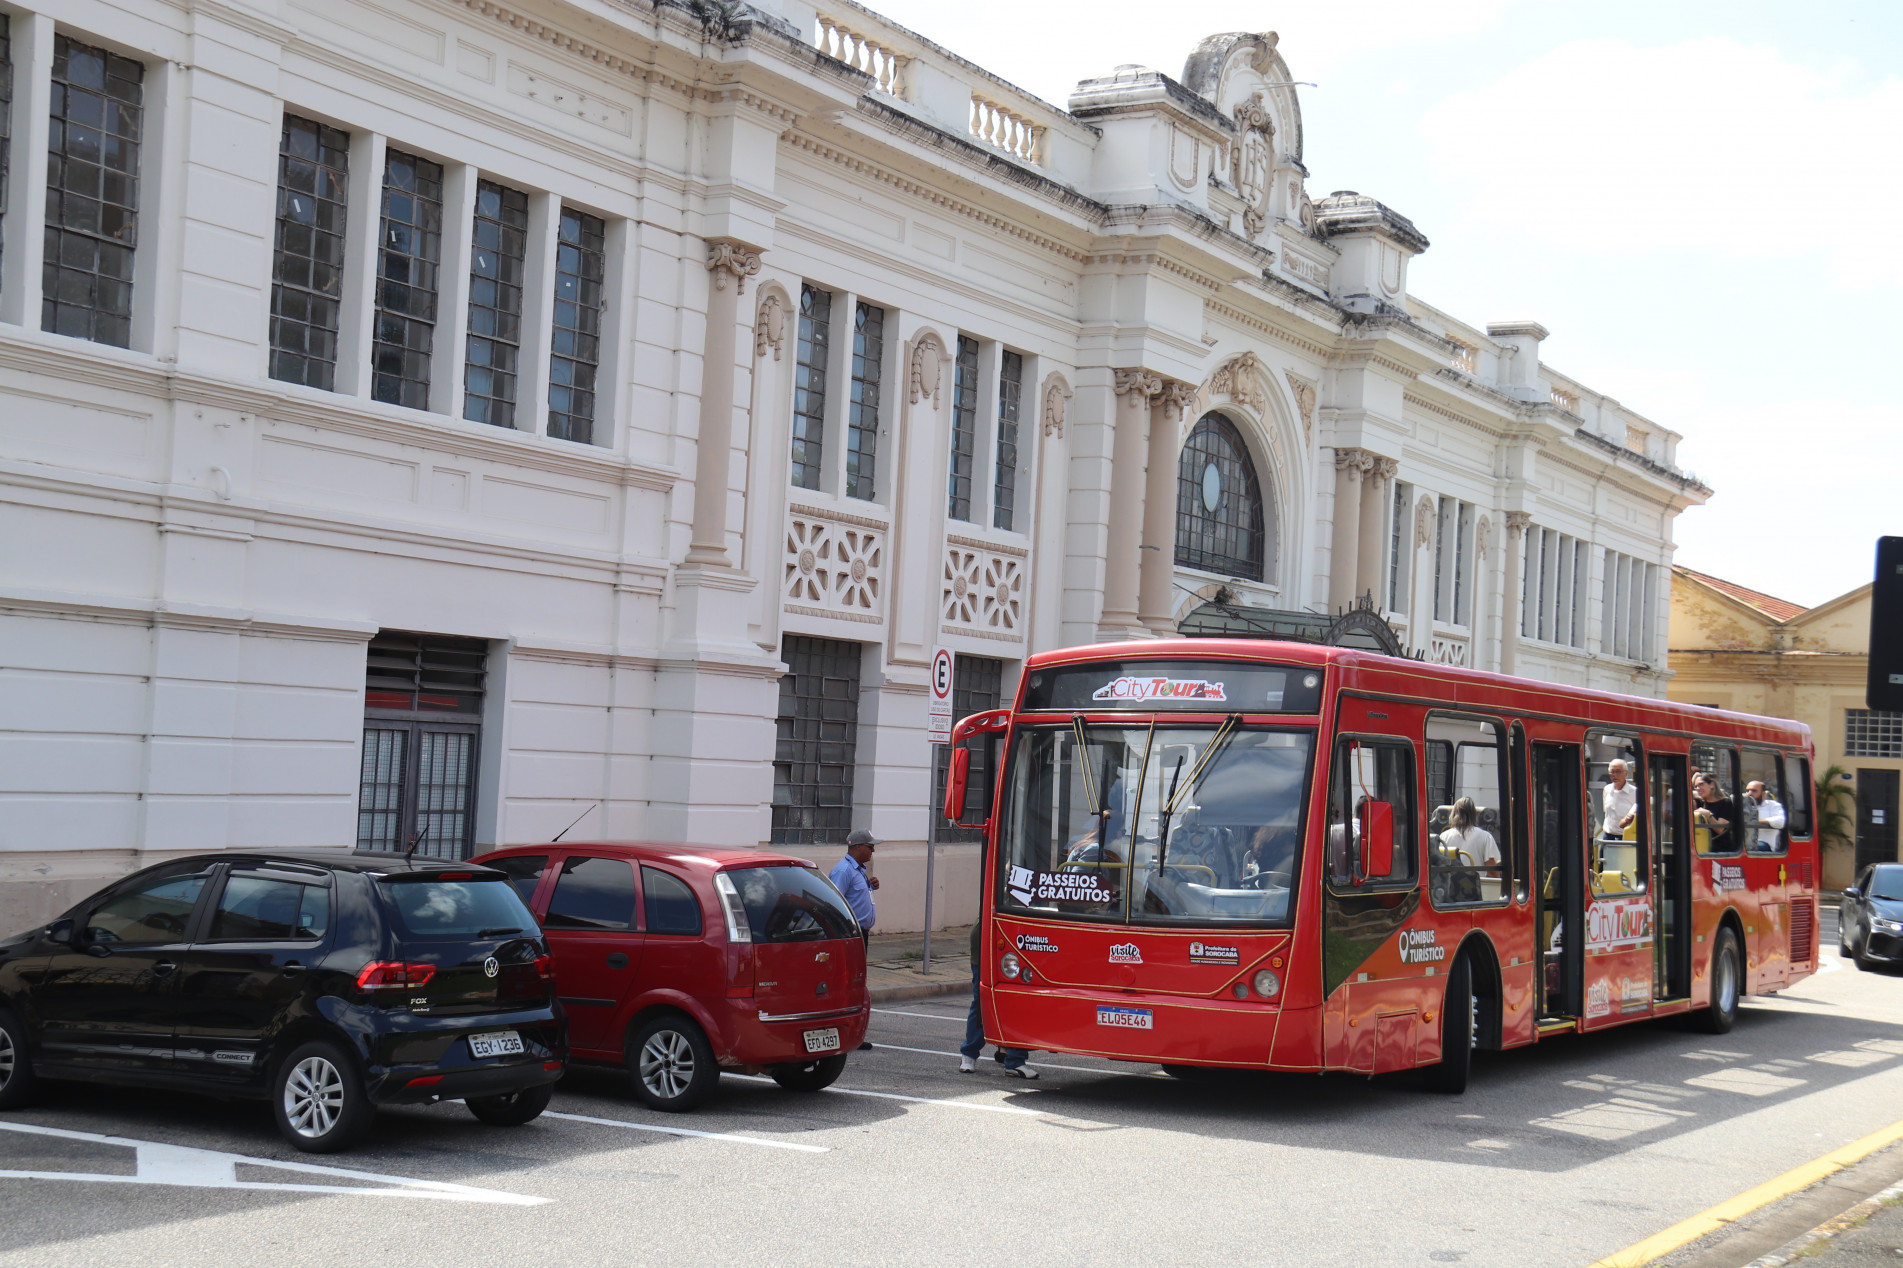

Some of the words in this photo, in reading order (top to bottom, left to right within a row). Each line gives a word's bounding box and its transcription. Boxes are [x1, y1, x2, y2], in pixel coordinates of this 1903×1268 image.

[938, 660, 946, 688] E
[1039, 873, 1098, 888] PASSEIOS
[1038, 886, 1110, 902] GRATUITOS
[1025, 934, 1048, 944] ÔNIBUS
[1409, 928, 1434, 944] ÔNIBUS
[1025, 943, 1058, 952] TURÍSTICO
[1409, 944, 1444, 962] TURÍSTICO
[1101, 1012, 1146, 1027] ELQ5E46
